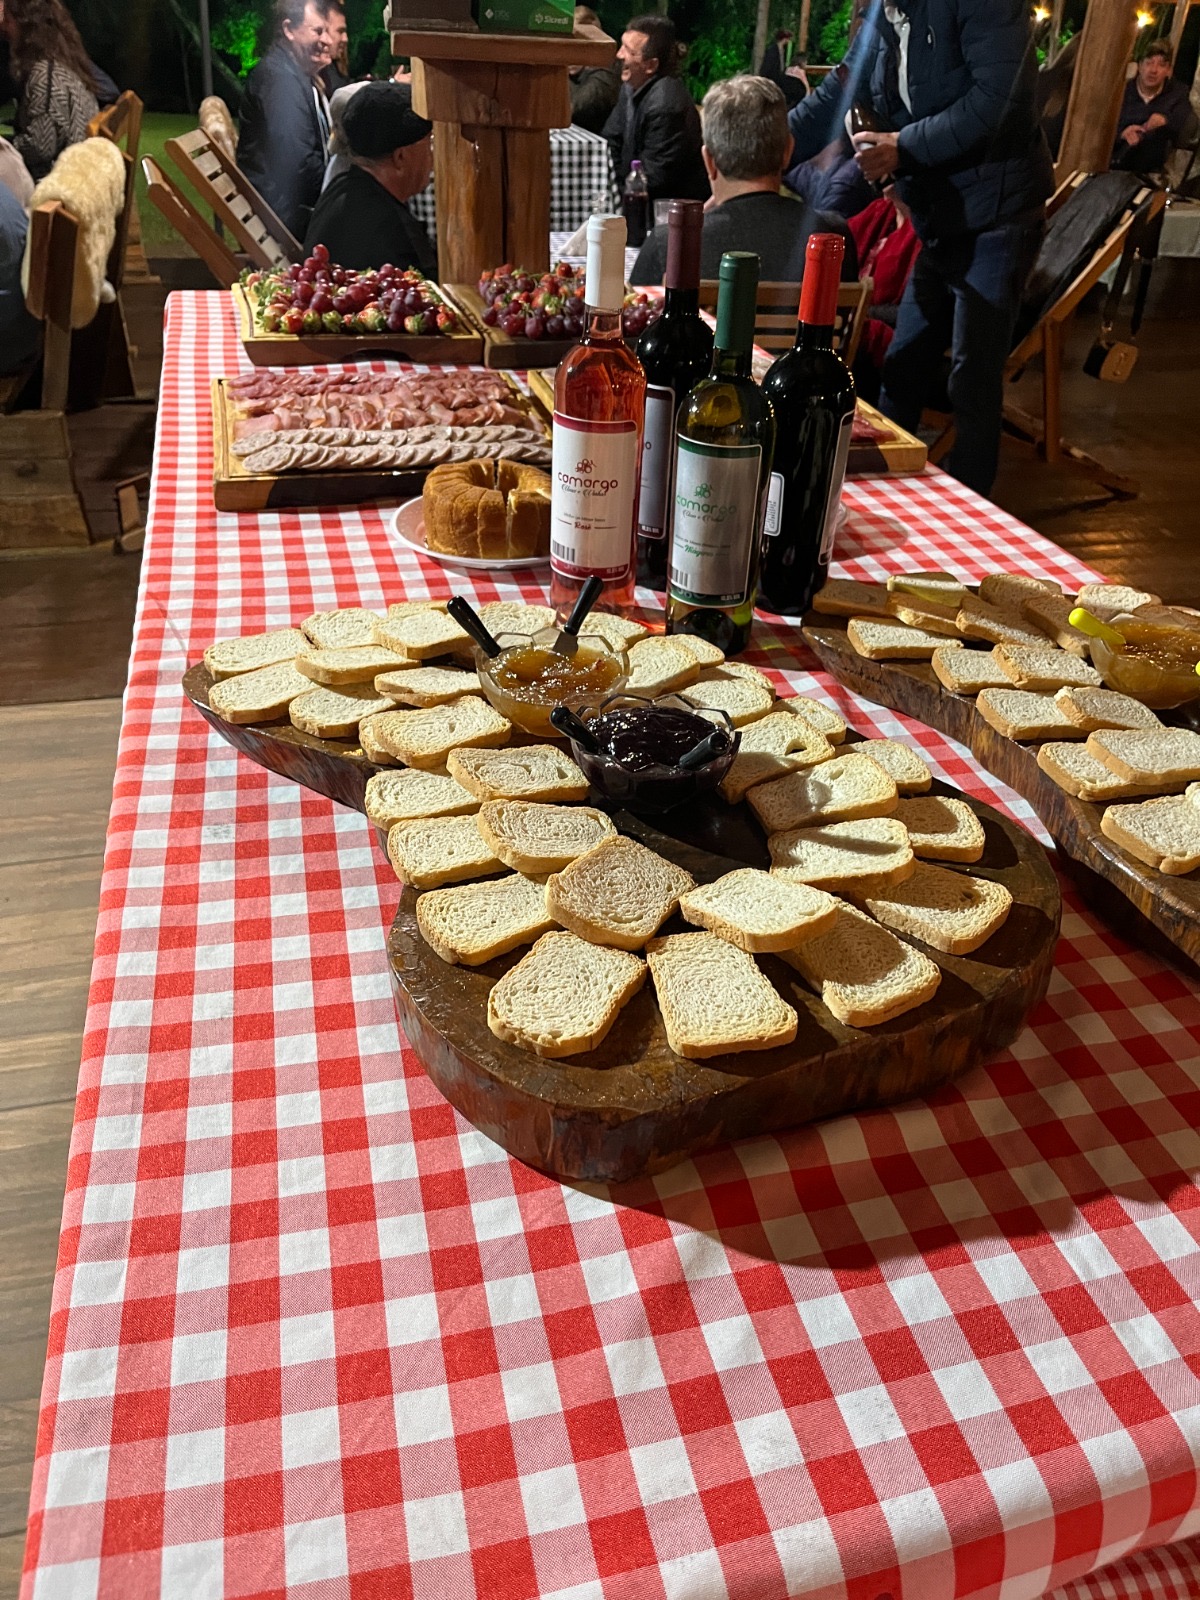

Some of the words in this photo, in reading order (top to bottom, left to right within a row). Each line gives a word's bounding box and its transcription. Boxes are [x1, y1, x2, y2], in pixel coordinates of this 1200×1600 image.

[544, 15, 569, 25] Sicredi
[558, 472, 619, 493] camargo
[676, 495, 737, 518] camargo
